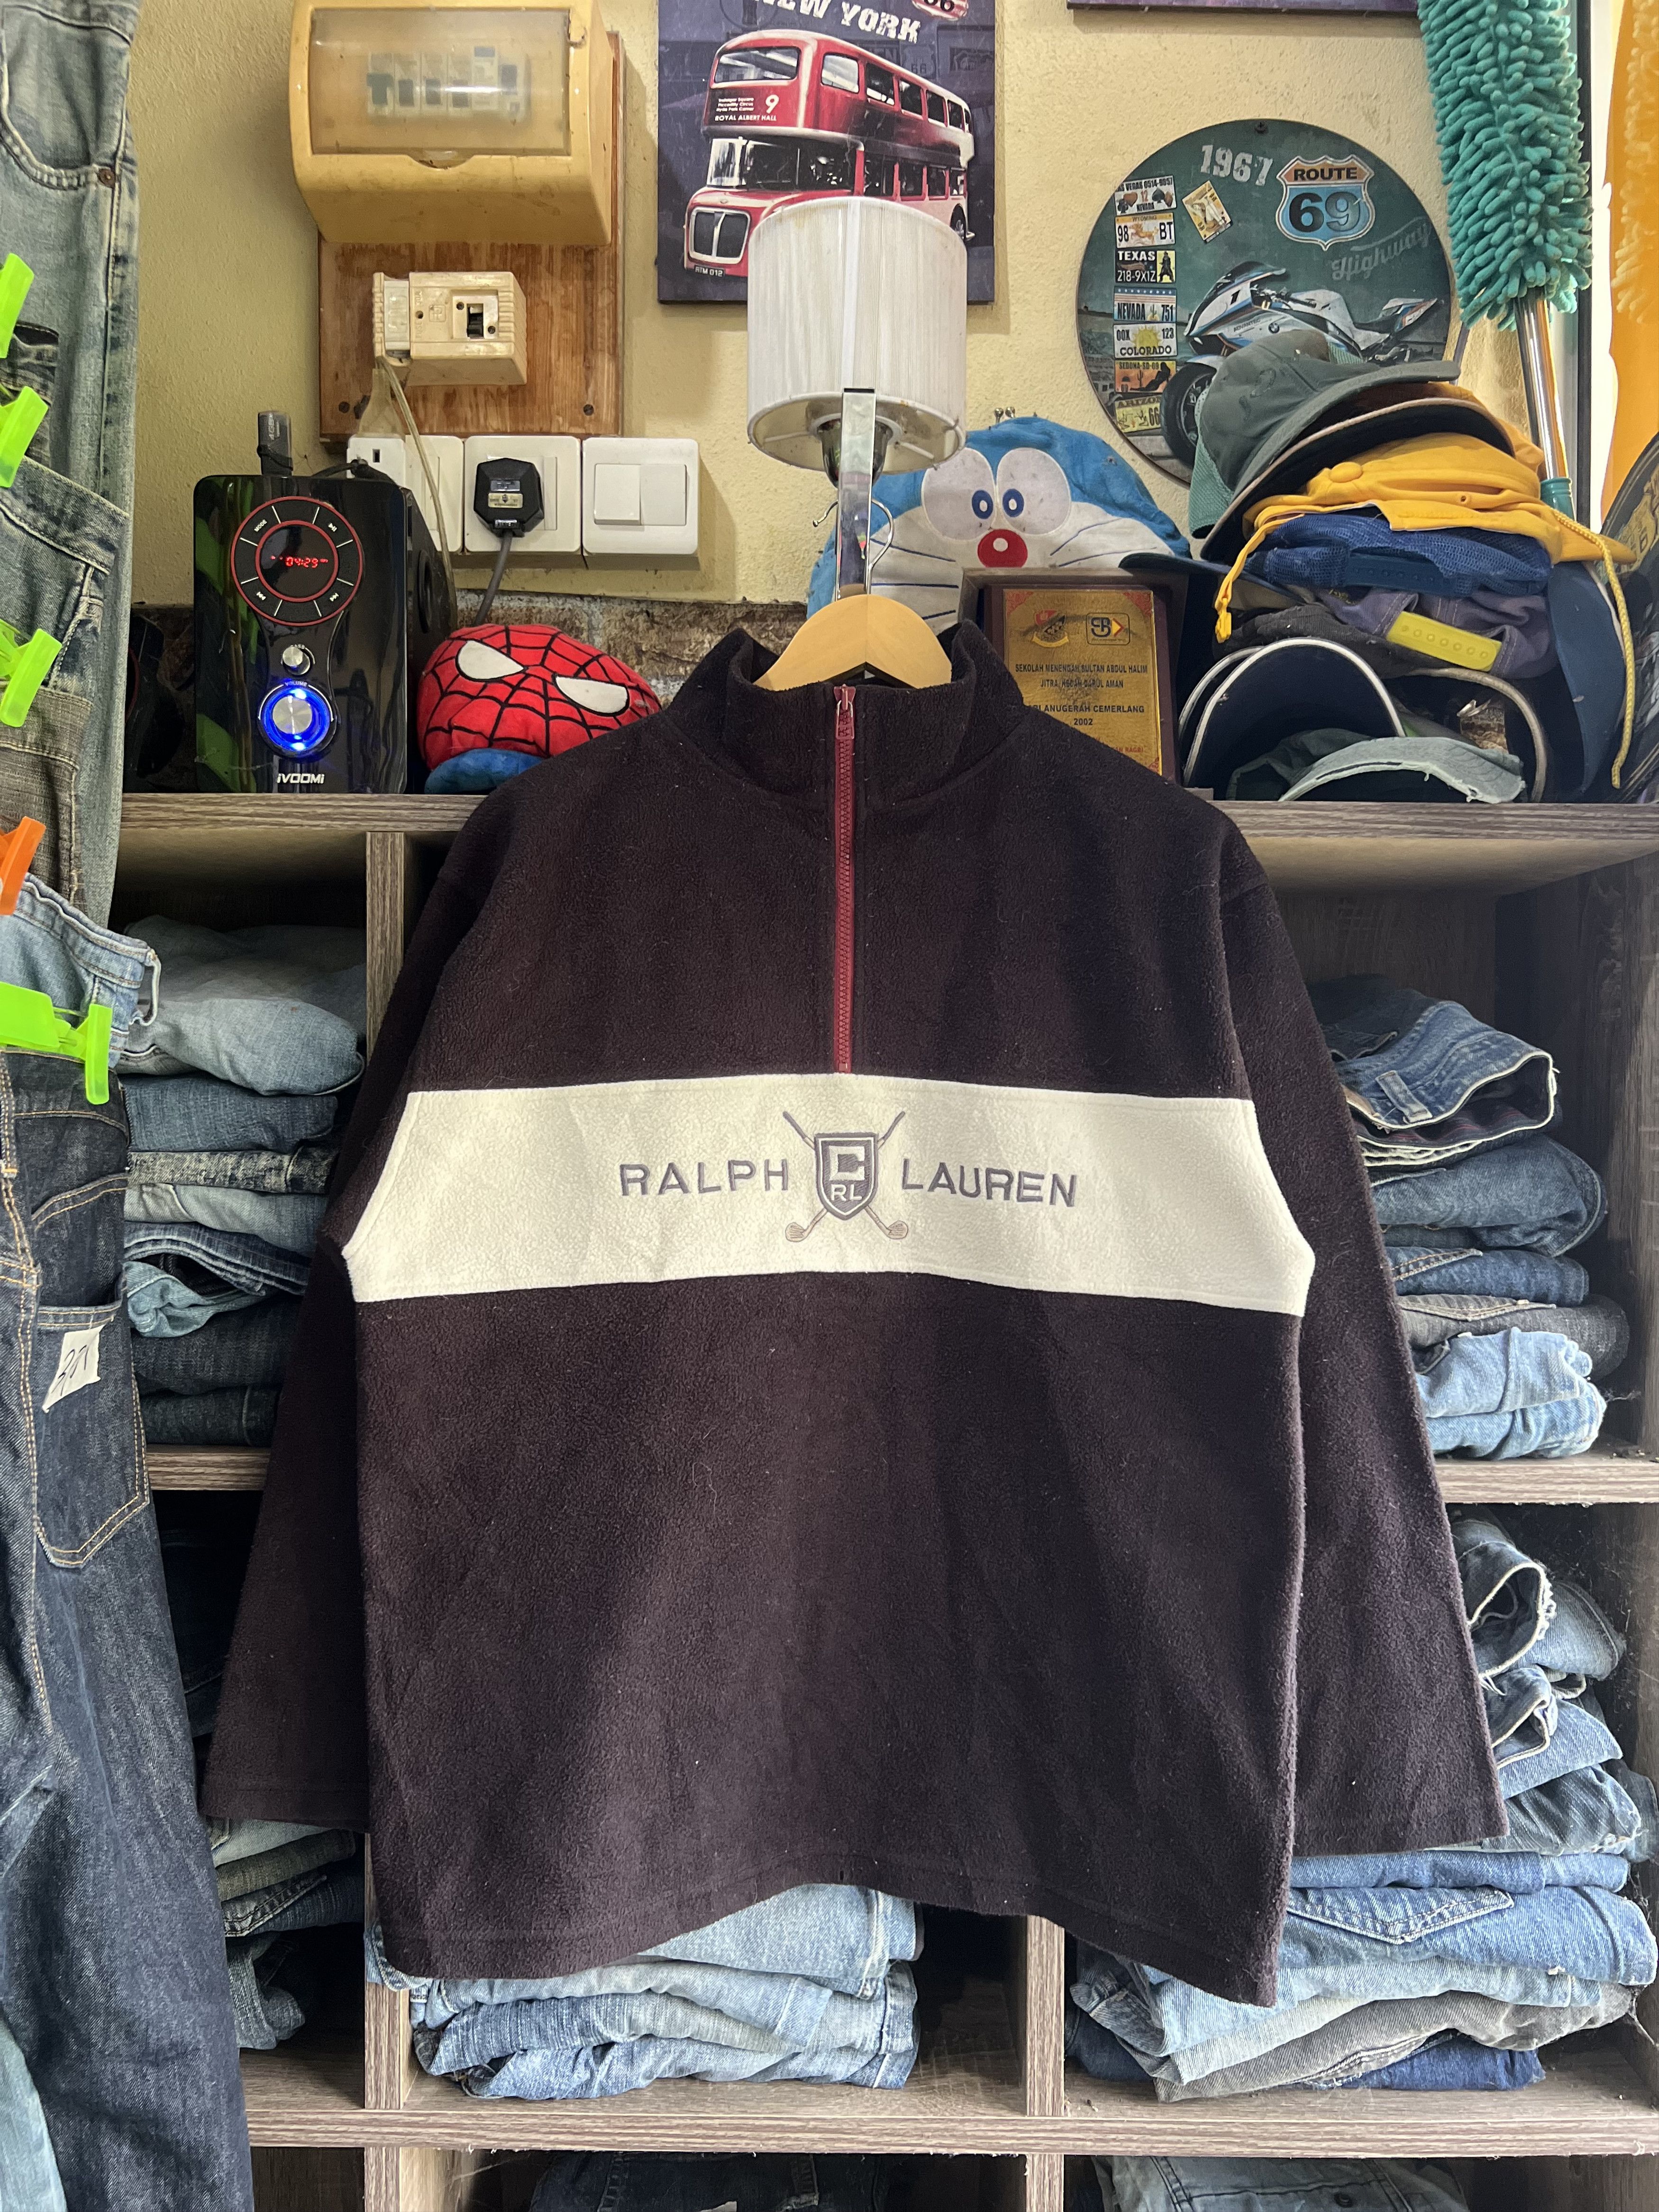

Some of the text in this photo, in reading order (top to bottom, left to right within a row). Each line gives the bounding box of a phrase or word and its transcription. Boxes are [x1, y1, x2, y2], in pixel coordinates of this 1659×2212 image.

[841, 1, 921, 44] YORK
[765, 94, 780, 114] 9
[1200, 144, 1274, 187] 1967
[1294, 167, 1358, 182] ROUTE
[1289, 191, 1361, 232] 69
[1117, 222, 1173, 242] 98 BT
[1117, 251, 1156, 261] TEXAS
[1331, 223, 1432, 281] Highway
[1117, 302, 1174, 321] NEVADA 751
[1162, 328, 1174, 339] 123
[1120, 345, 1172, 356] COLORADO
[254, 519, 267, 532] MODE
[285, 556, 318, 568] 04:29
[1015, 664, 1148, 674] SEKOLAH MENENGAH SULTAN ABDUL HALIM
[1105, 680, 1124, 688] AMAN
[620, 1159, 789, 1197] RALPH
[902, 1158, 1077, 1208] LAUREN
[830, 1183, 862, 1202] RL
